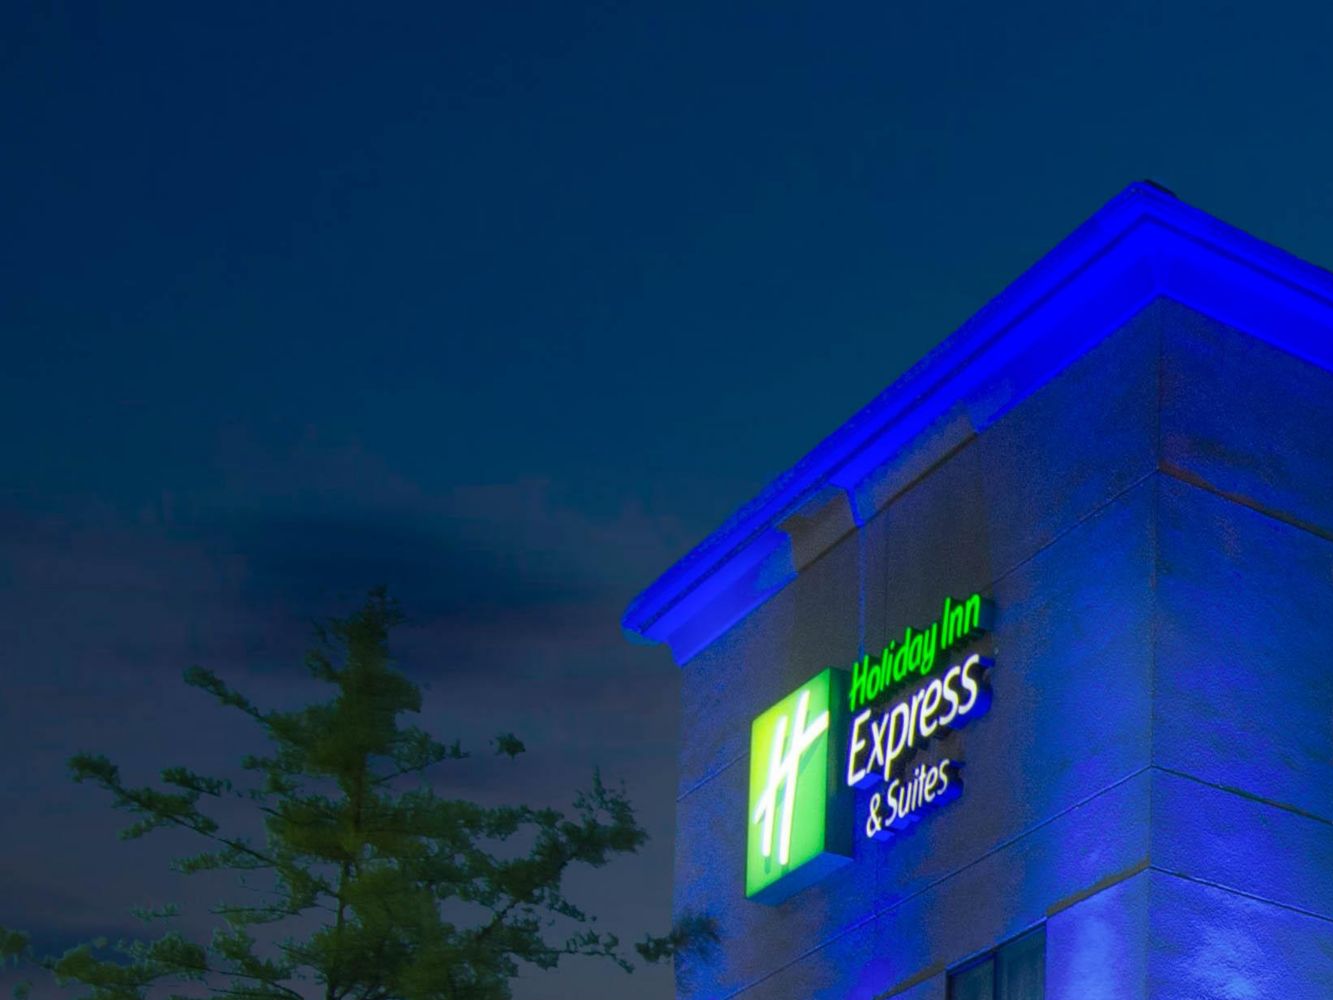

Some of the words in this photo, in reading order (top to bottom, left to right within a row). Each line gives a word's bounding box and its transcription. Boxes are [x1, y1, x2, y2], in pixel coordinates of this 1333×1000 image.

[850, 622, 938, 711] Holiday
[942, 594, 981, 649] Inn
[848, 654, 980, 786] Express
[866, 793, 882, 838] &
[885, 759, 950, 827] Suites
